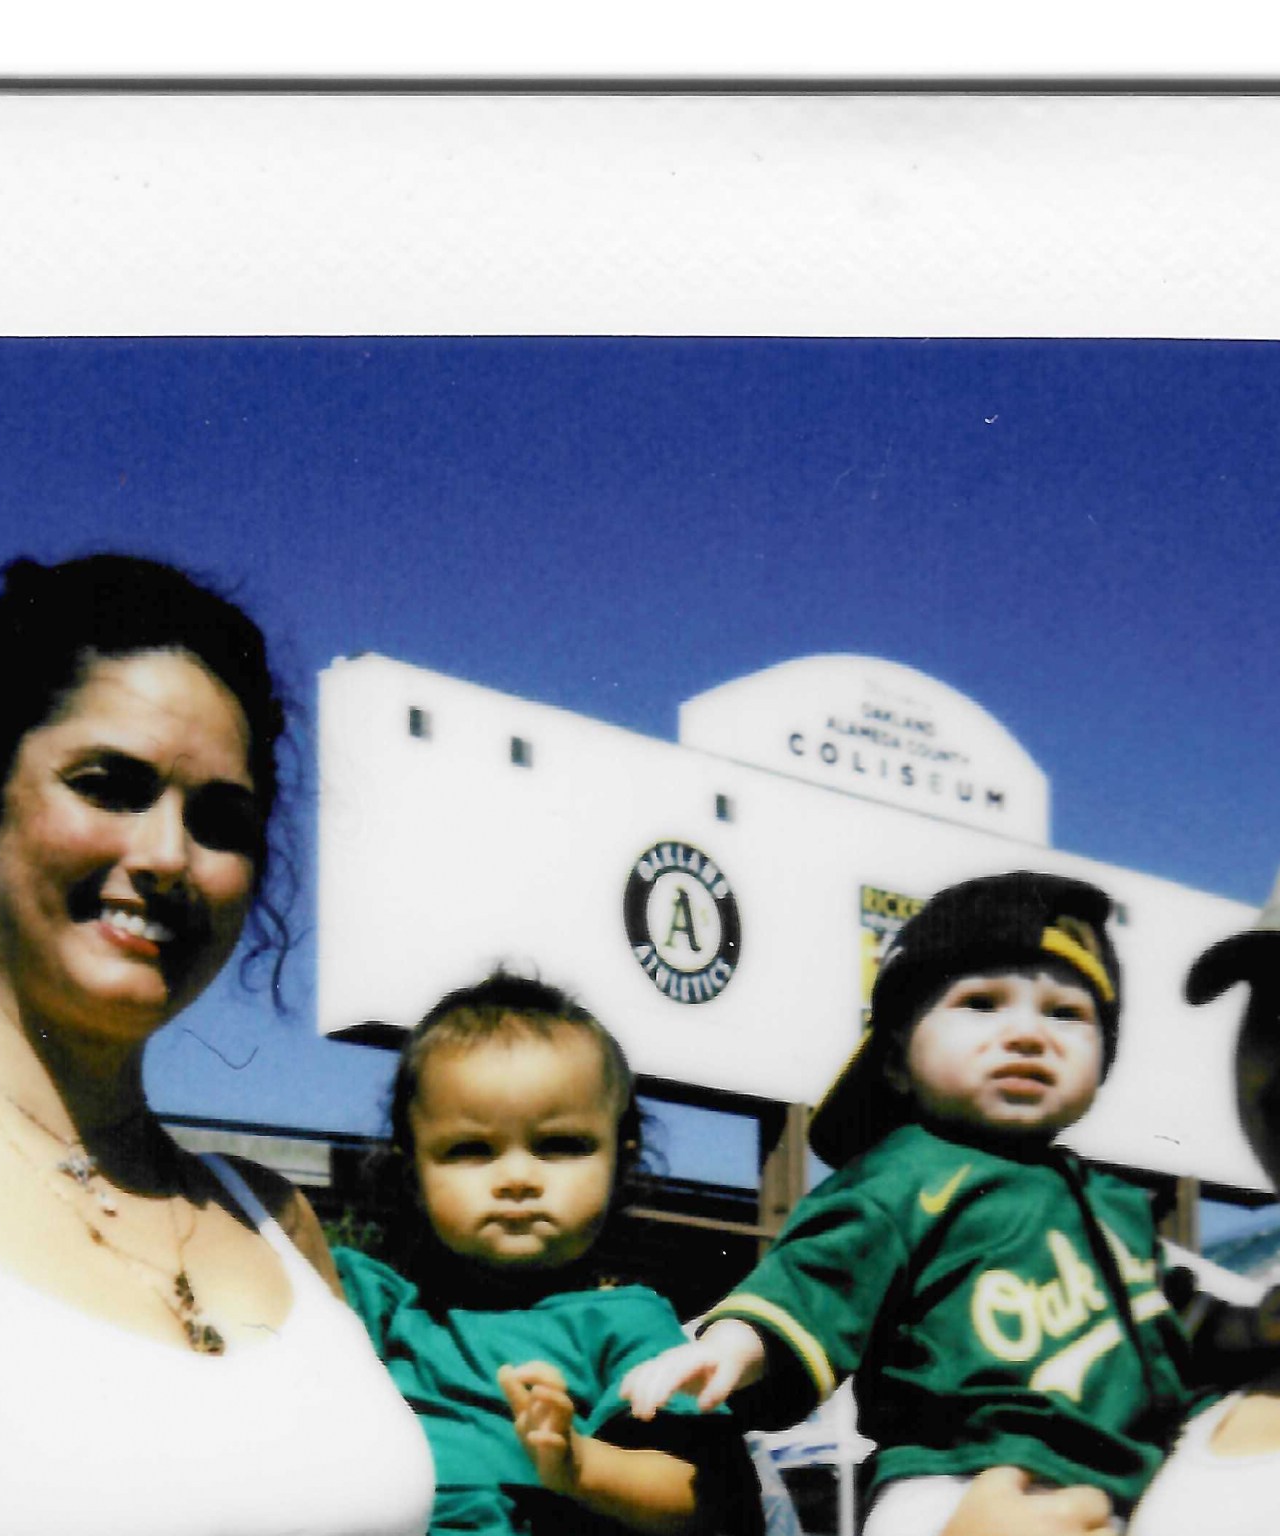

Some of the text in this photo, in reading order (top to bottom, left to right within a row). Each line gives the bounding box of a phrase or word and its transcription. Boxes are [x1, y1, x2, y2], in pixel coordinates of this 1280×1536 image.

[788, 732, 1006, 811] COLISEUM
[636, 843, 731, 900] OAKLAND
[633, 944, 732, 1003] ATHLETICS
